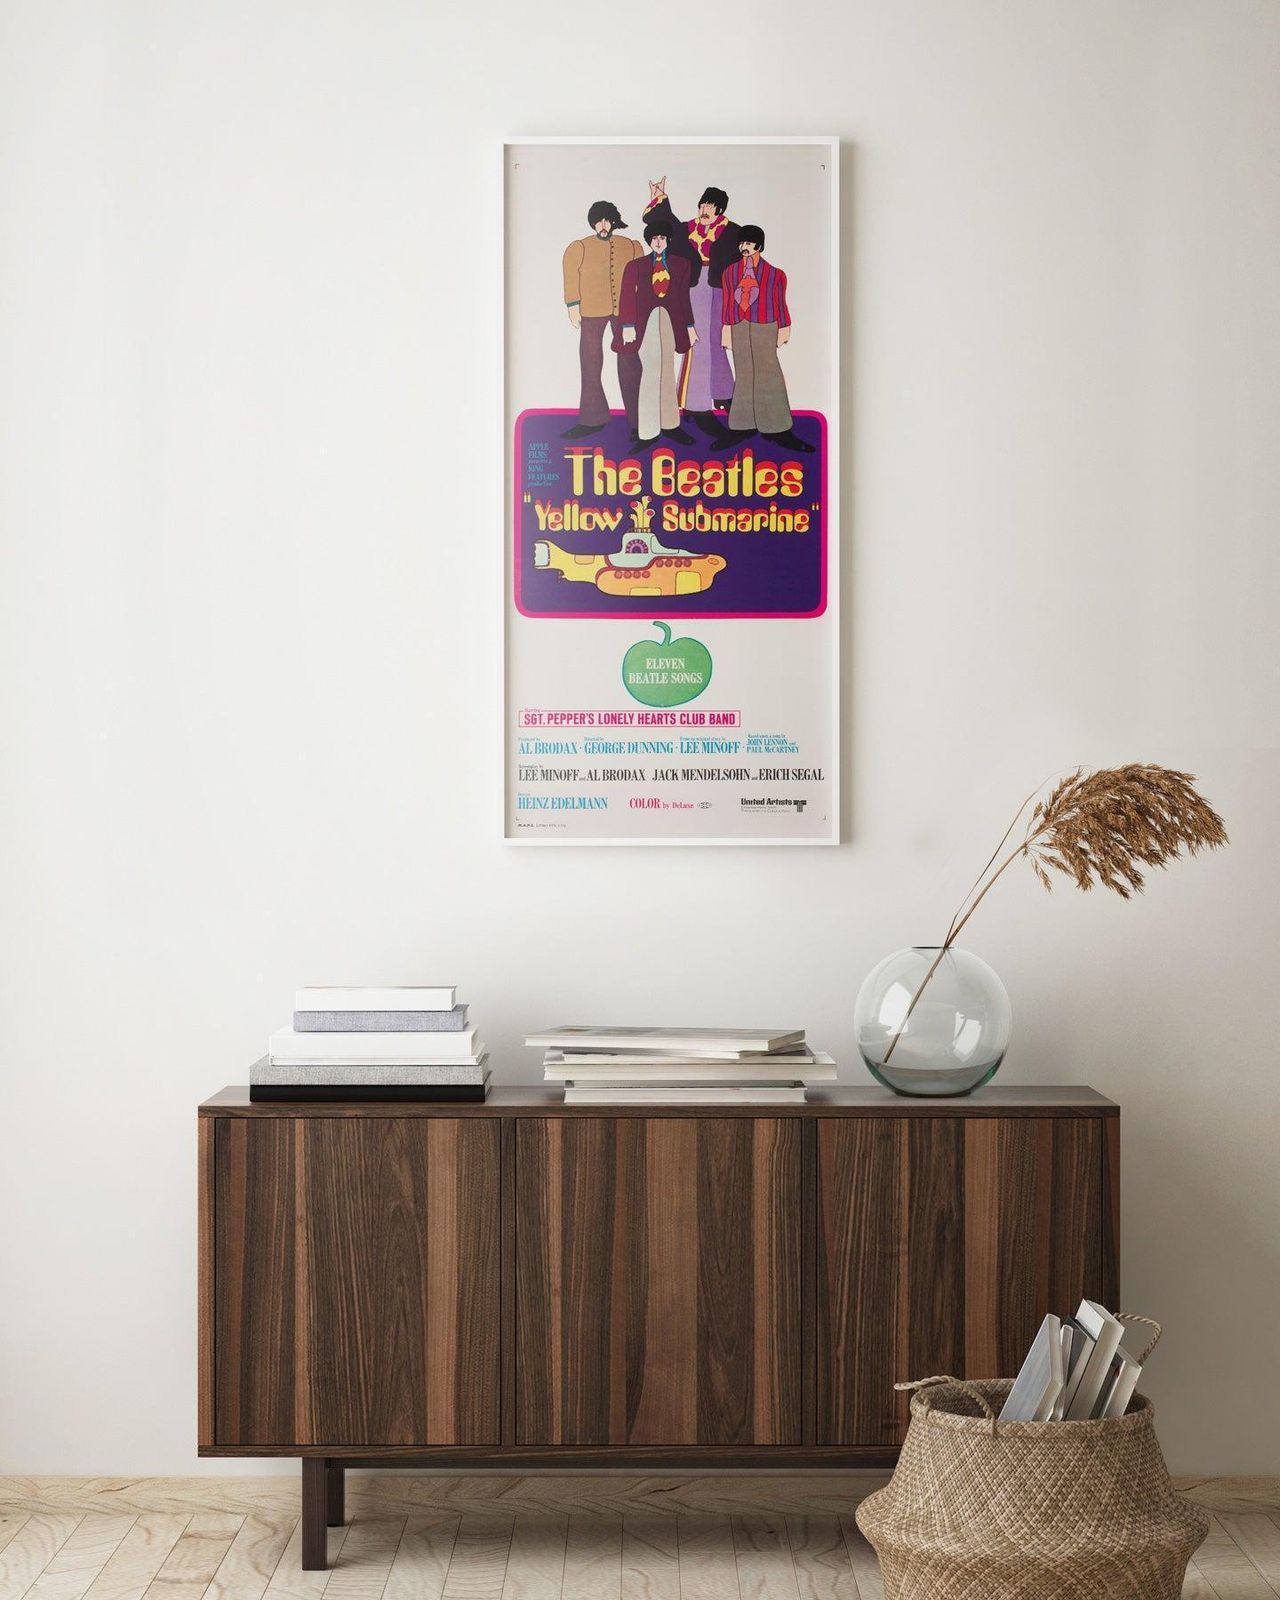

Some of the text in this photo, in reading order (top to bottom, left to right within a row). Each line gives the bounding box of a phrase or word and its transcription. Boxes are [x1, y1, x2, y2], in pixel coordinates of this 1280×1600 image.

[528, 473, 560, 481] FEATURES
[563, 447, 804, 498] The Beatles
[646, 658, 685, 669] ELEVEN
[629, 672, 703, 684] BEATLE SONGS
[524, 713, 736, 725] SGT. PEPPER'S LONELY HEARTS CLUB BAND
[518, 741, 740, 754] AL BRODAX GEORGE DUNNING LEE MINOFF
[746, 738, 762, 746] JOHN
[764, 738, 788, 746] LENNON
[519, 769, 538, 781] LEE
[540, 769, 580, 781] MINOFF
[586, 769, 601, 781] AL
[602, 769, 645, 781] BRODAX
[651, 769, 679, 781] JACK
[681, 768, 750, 781] MENDELSOHN
[759, 768, 790, 781] ERICH
[791, 768, 824, 781] SEGAL
[518, 797, 608, 809] HEINZ EDELMANN
[629, 798, 660, 809] COLOR
